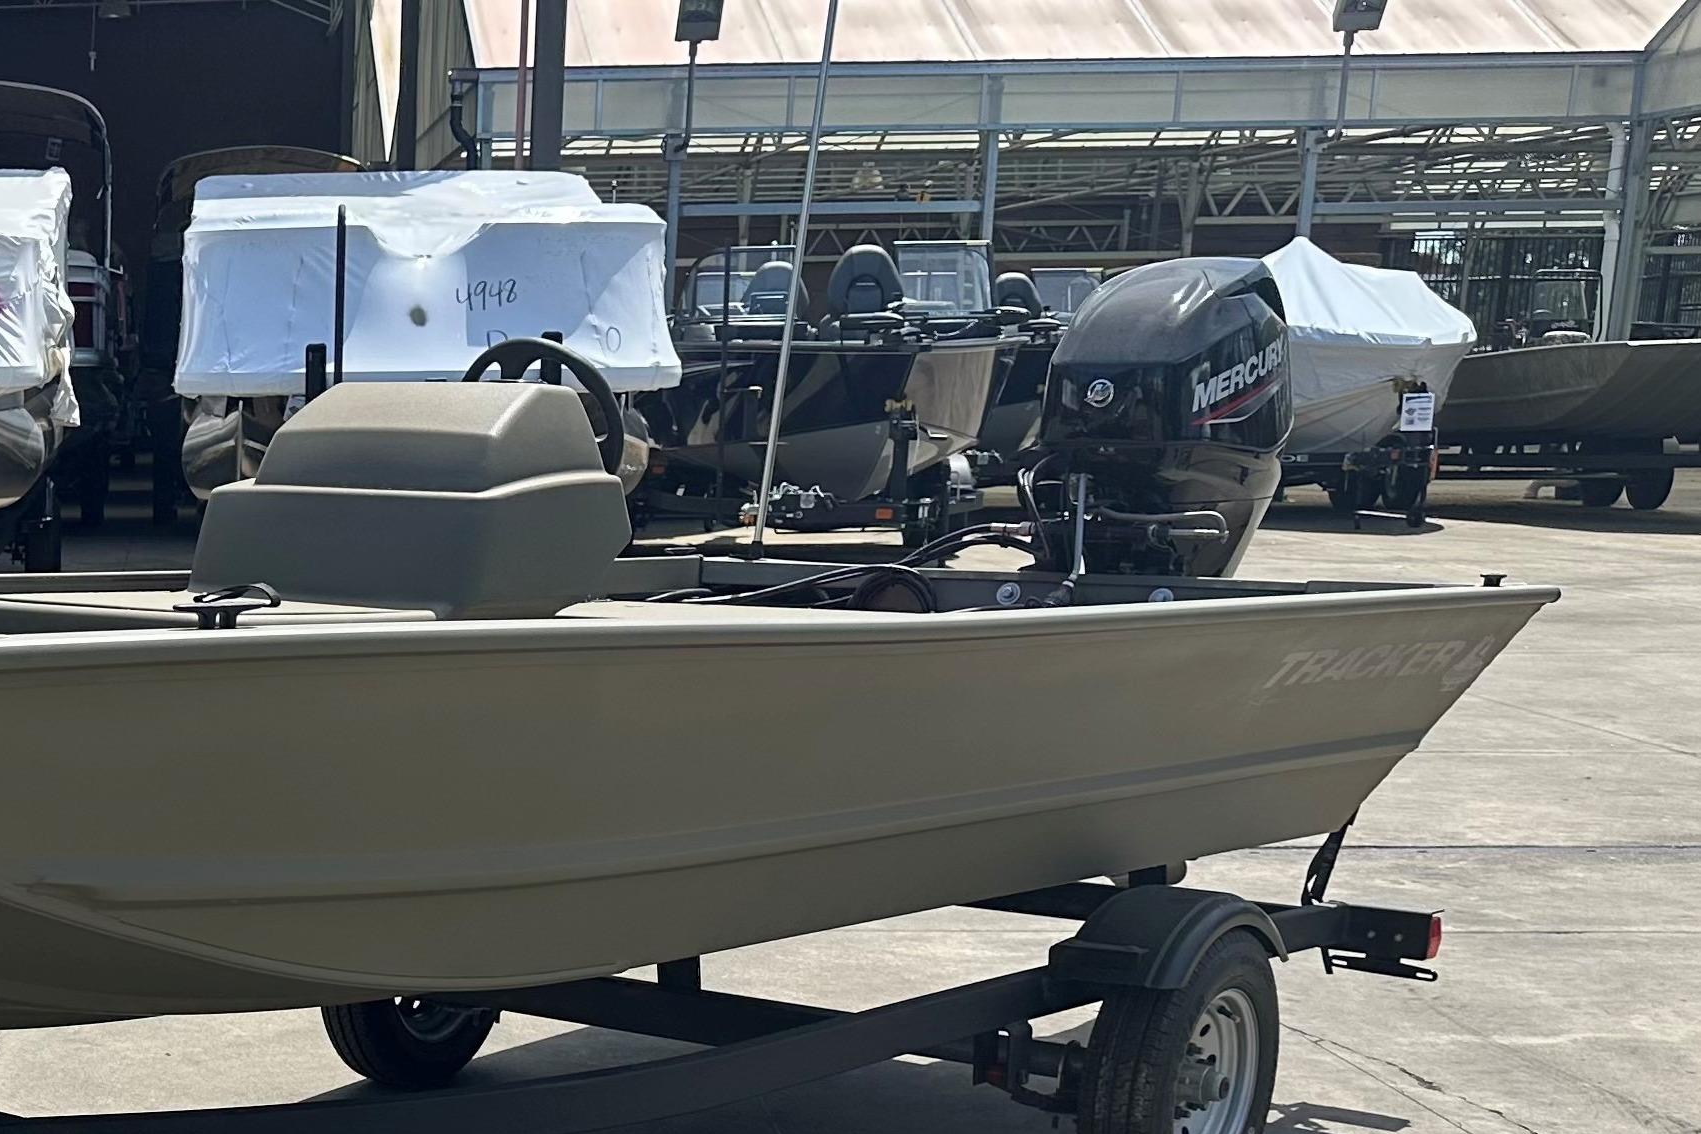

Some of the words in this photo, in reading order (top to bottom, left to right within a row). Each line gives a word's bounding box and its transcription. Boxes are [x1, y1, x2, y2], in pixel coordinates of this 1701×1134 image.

[455, 278, 517, 311] 4948
[1191, 333, 1284, 413] MERCURY
[1262, 639, 1467, 690] TRACKER
